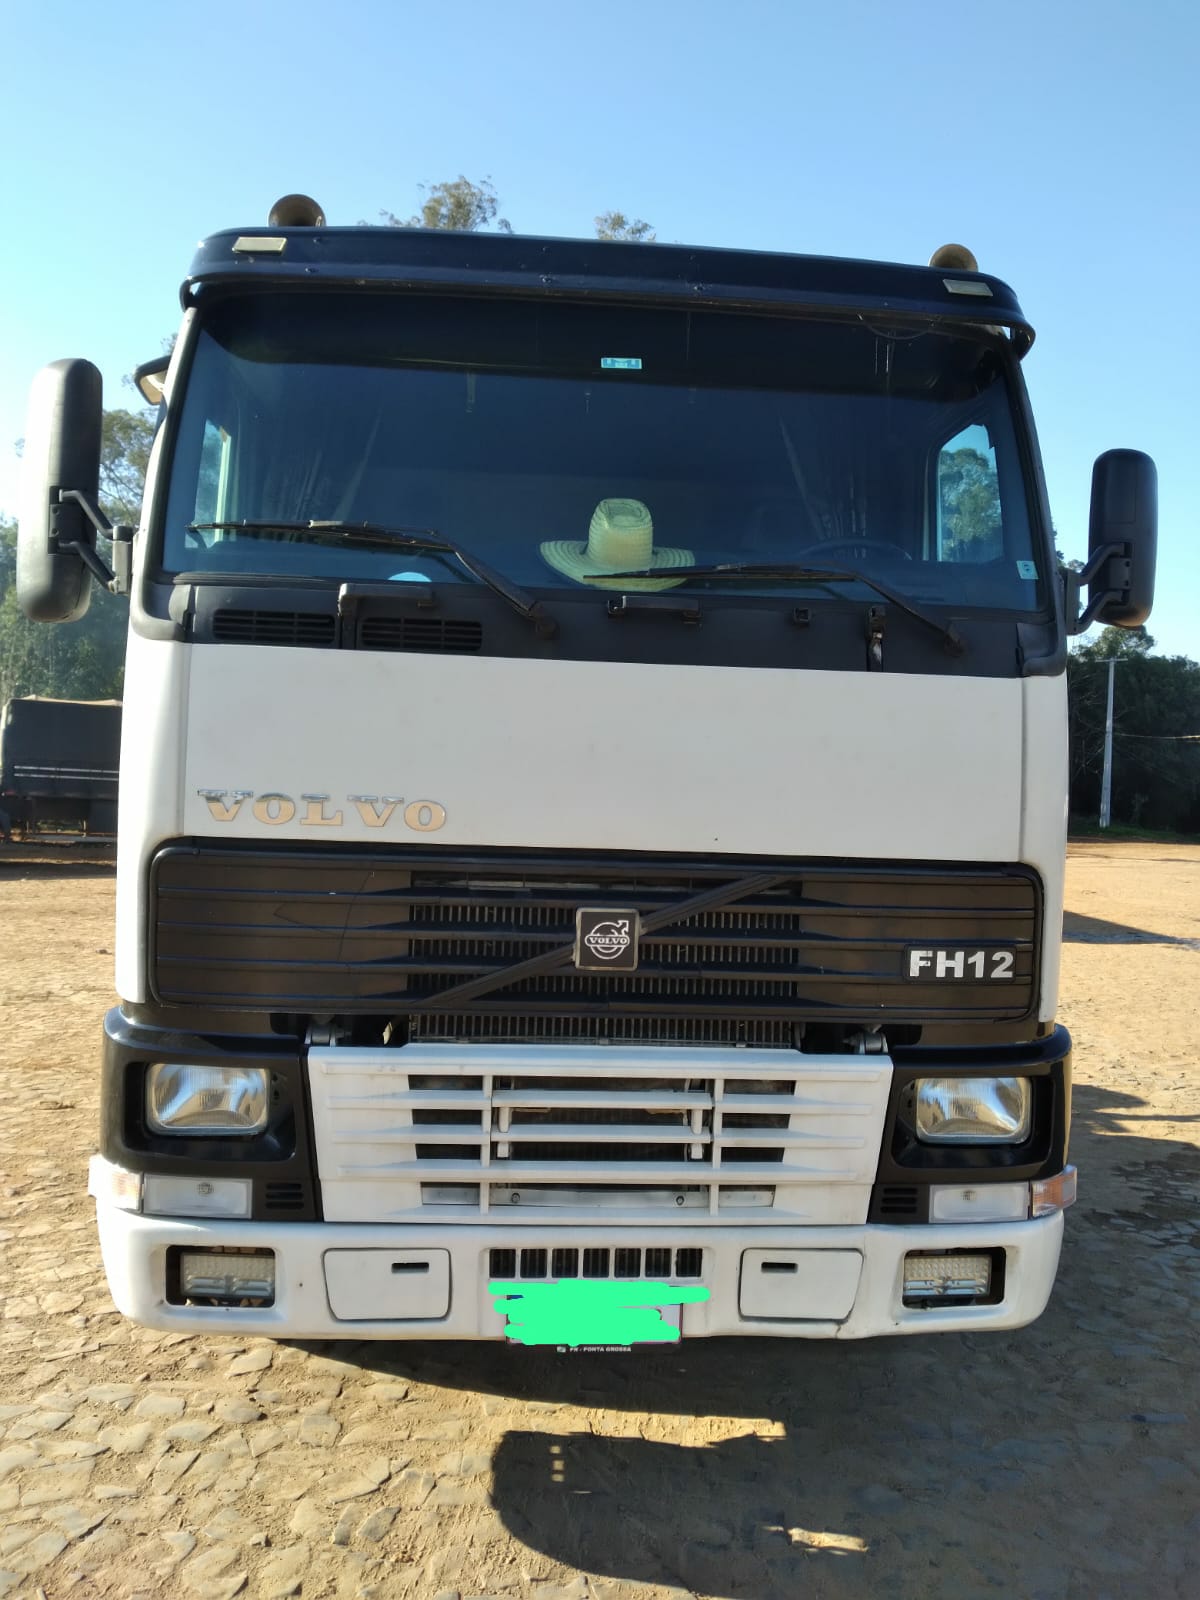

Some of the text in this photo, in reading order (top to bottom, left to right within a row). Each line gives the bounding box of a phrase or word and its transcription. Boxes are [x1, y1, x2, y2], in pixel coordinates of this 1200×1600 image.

[198, 789, 447, 832] VOLVO
[589, 936, 628, 944] VOLVO
[909, 950, 1014, 979] FH12
